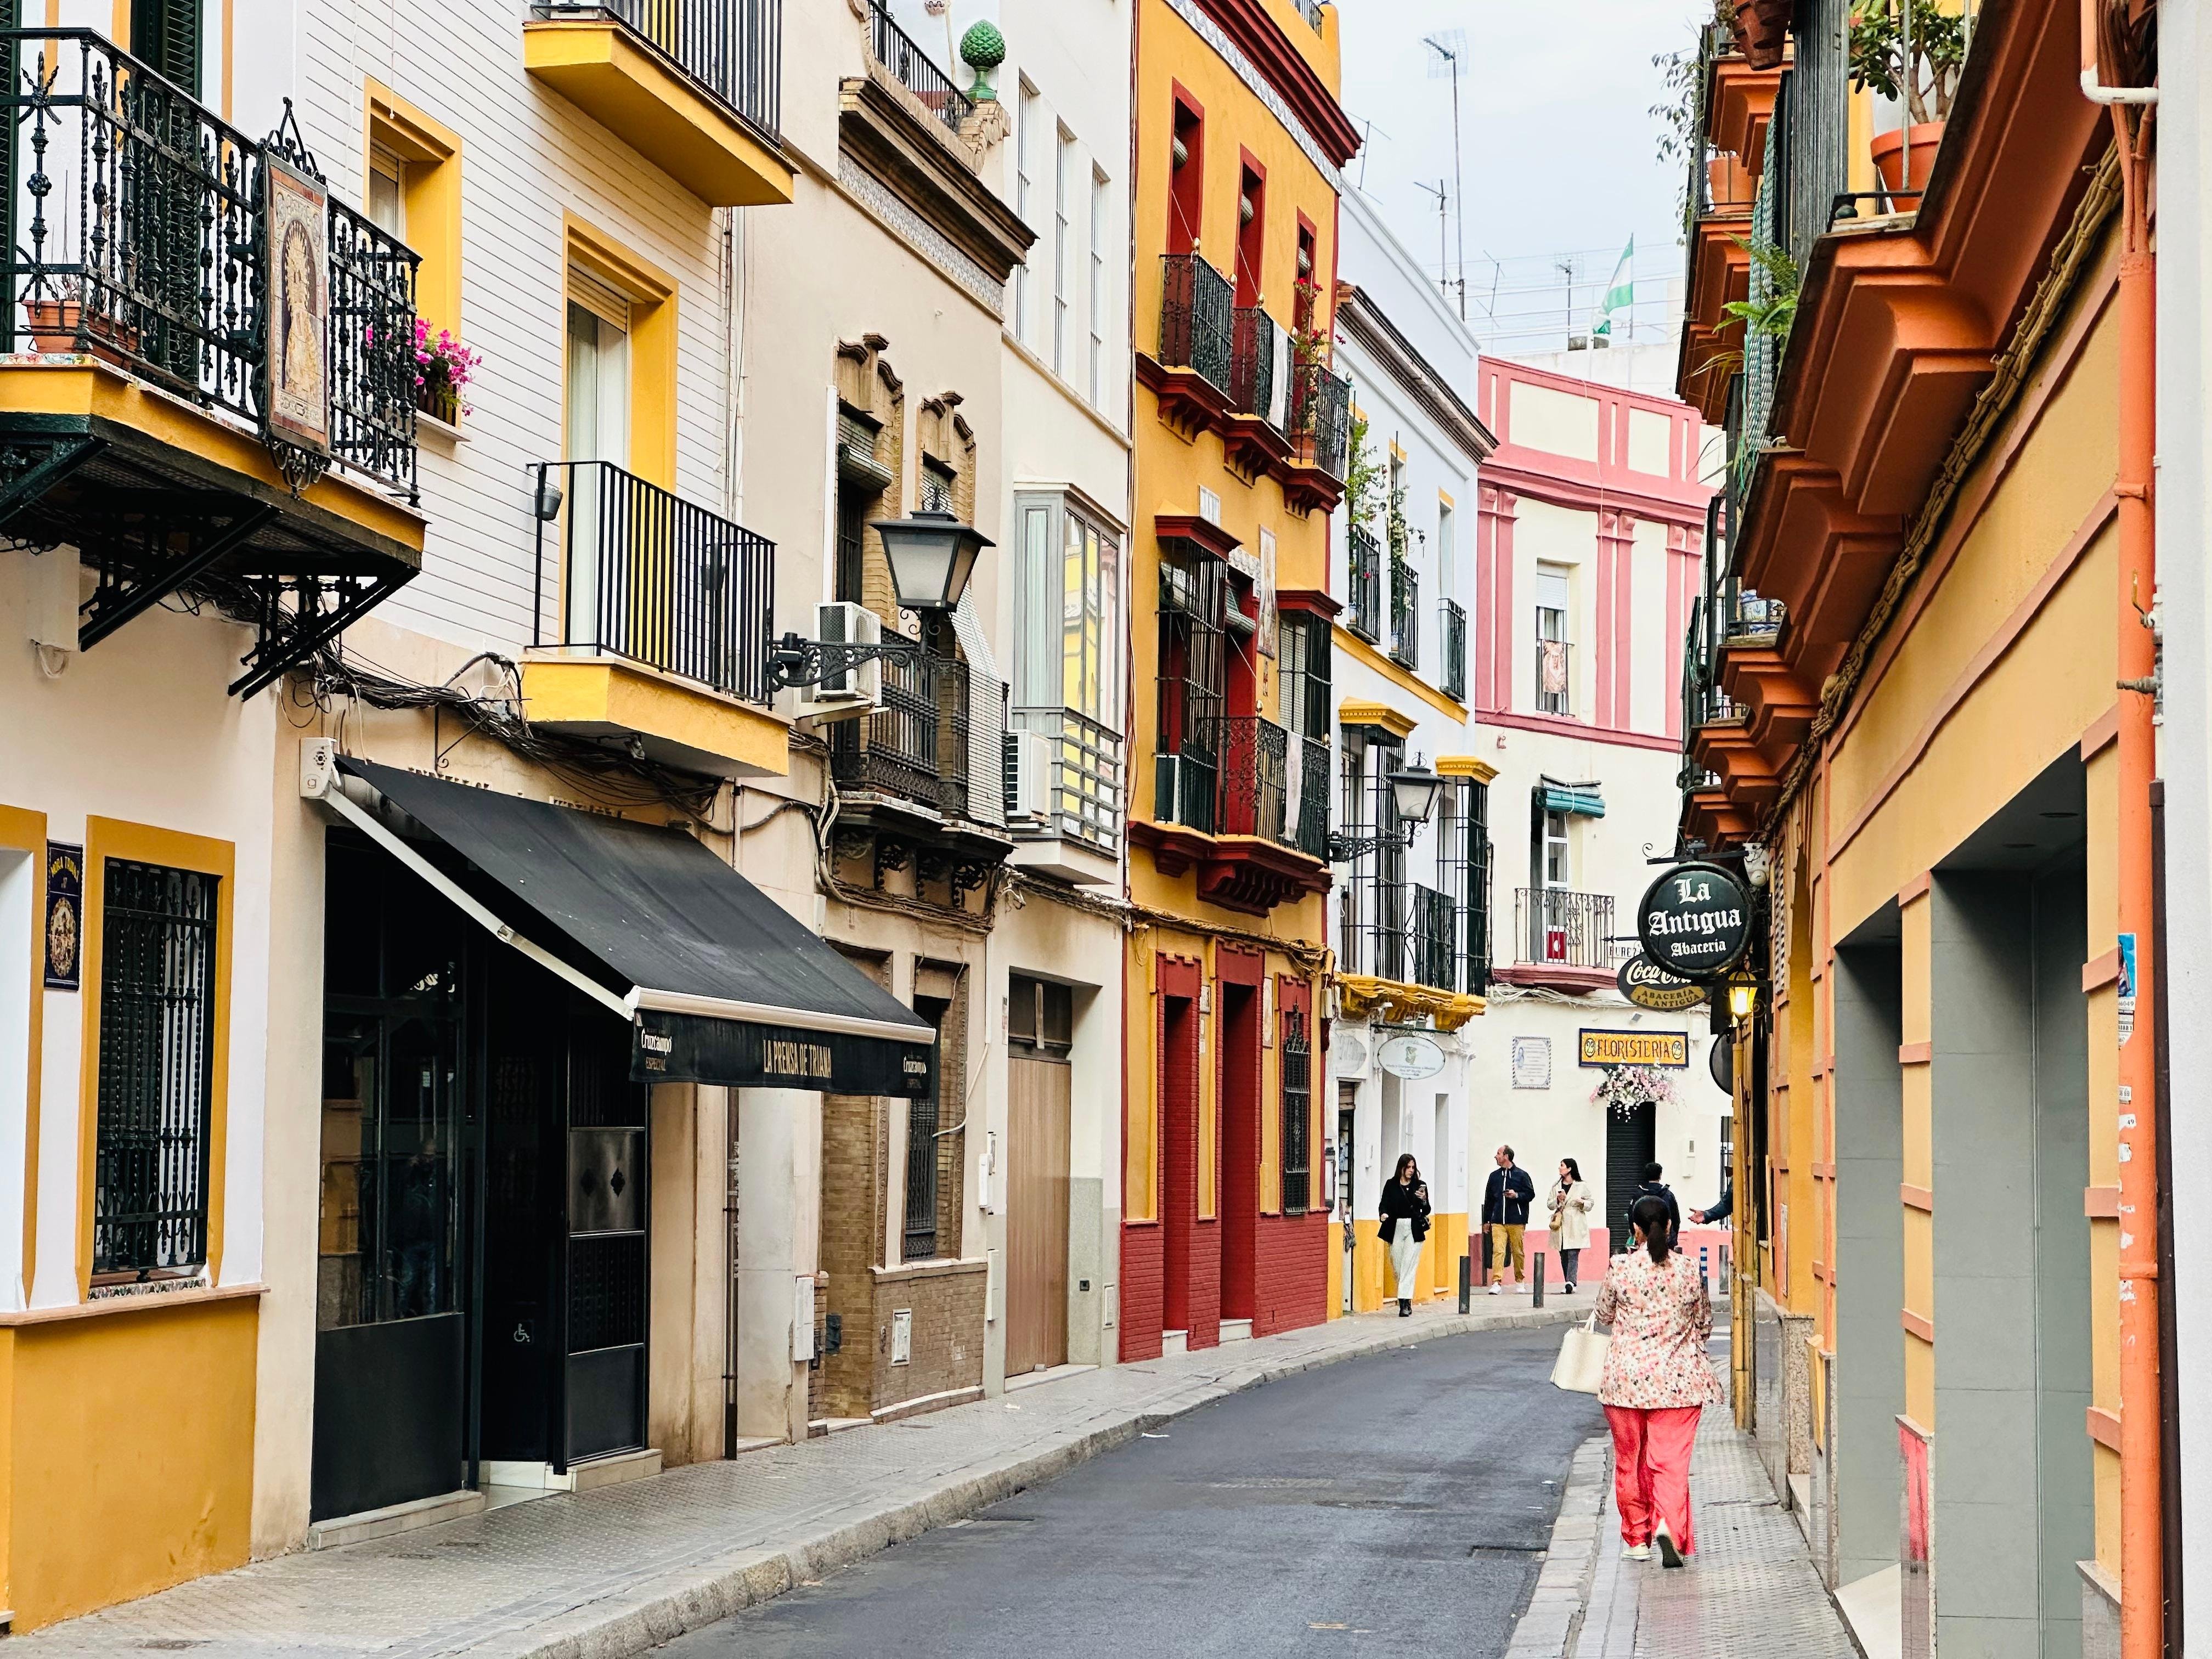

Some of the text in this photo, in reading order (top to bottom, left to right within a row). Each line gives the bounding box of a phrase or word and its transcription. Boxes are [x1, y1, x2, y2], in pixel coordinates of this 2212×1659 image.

[1674, 878, 1712, 904] La
[1648, 909, 1742, 936] Antigua
[1635, 994, 1700, 1007] LA ANTIGUA
[1641, 988, 1695, 1000] ABACERÍA
[763, 1040, 832, 1079] LA PRENSA DE TRIANA
[1597, 1039, 1671, 1059] FLORISTERIA
